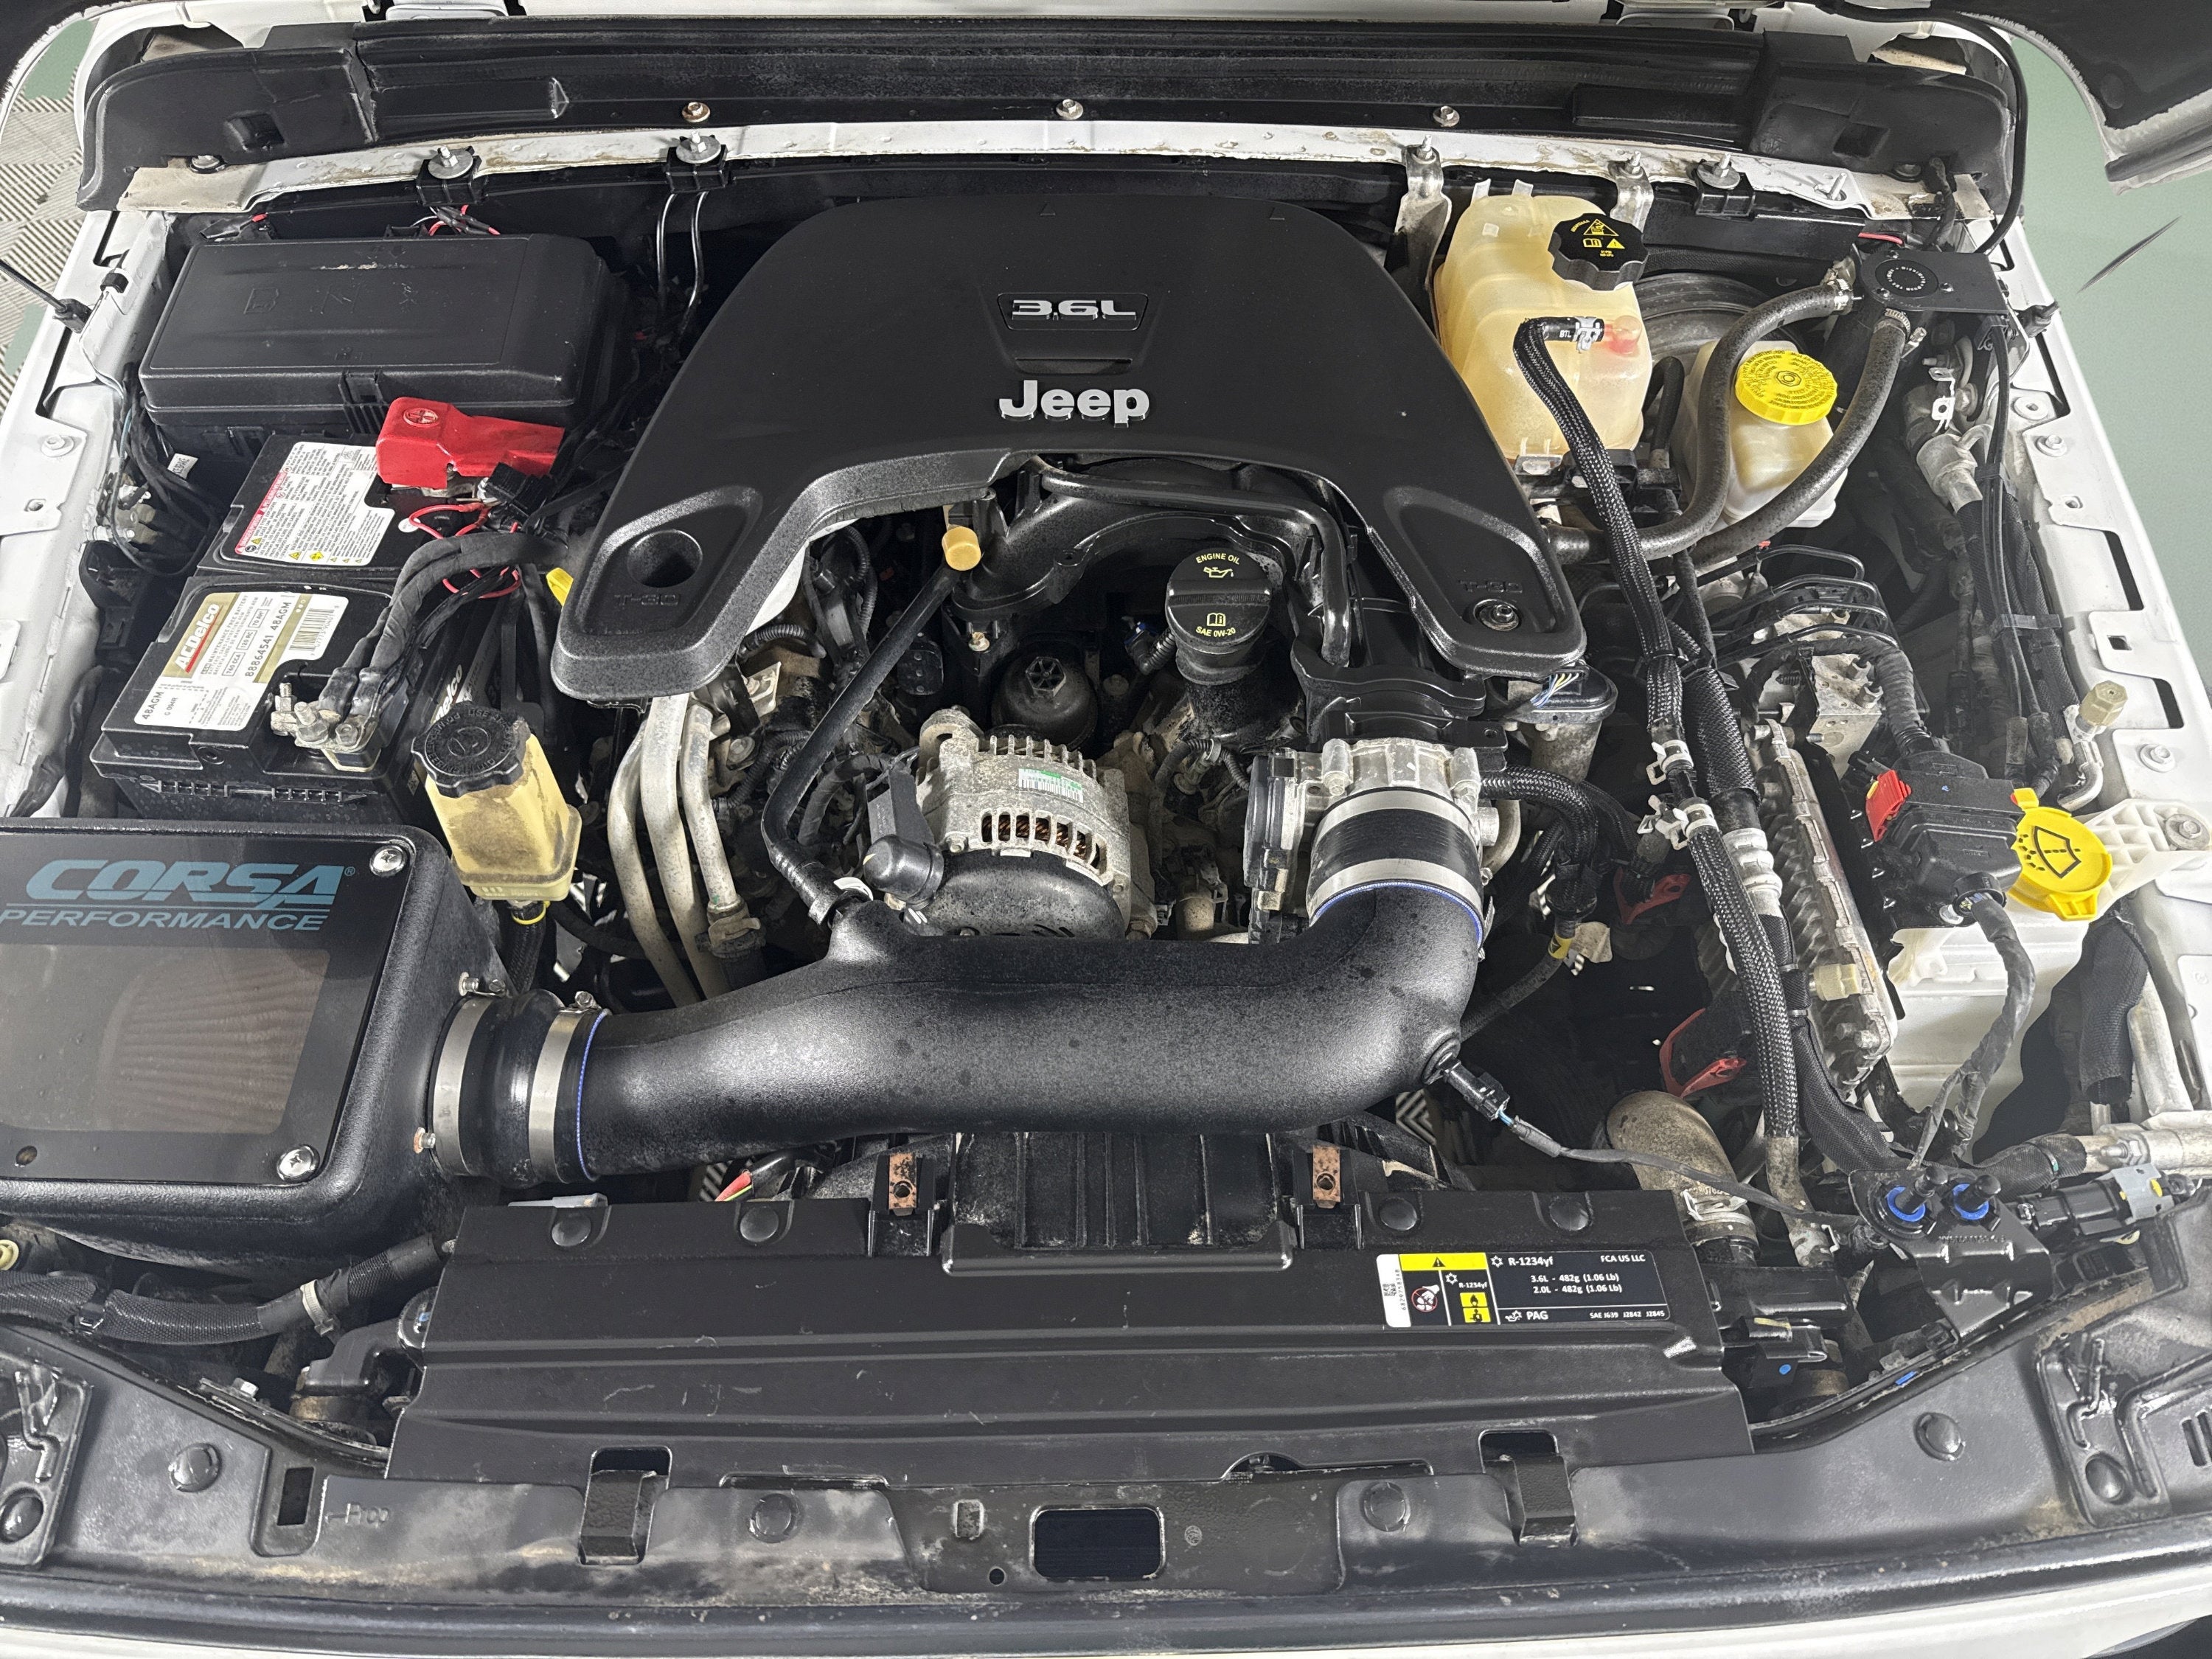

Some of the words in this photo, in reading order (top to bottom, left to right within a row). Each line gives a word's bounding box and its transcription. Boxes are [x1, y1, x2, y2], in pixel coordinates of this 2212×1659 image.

[1012, 299, 1136, 320] 3.6L
[998, 379, 1150, 426] Jeep
[1195, 553, 1226, 564] ENGINE
[1228, 554, 1240, 565] OIL
[175, 603, 220, 670] ACDelco
[245, 635, 274, 677] 88864541
[270, 602, 291, 631] 48AGM
[246, 630, 254, 639] RC
[1195, 626, 1211, 636] SAE
[1213, 627, 1236, 637] 0W-20
[226, 663, 236, 675] 760
[232, 653, 242, 663] CCA
[141, 691, 164, 720] 48AGM
[26, 859, 345, 909] CORSA
[0, 909, 329, 931] PERFORMANCE
[1508, 1256, 1554, 1267] R-1234yf
[1458, 1281, 1488, 1290] R-1234yf
[1530, 1274, 1549, 1283] 3.6L
[1559, 1274, 1579, 1284] 482g
[1582, 1273, 1603, 1284] (1.06
[1604, 1273, 1620, 1283] Lb)
[1532, 1285, 1551, 1294] 2.0L
[1562, 1284, 1582, 1295] 482g
[1585, 1284, 1606, 1294] (1.06
[1607, 1284, 1623, 1293] Lb)
[1526, 1311, 1548, 1321] PAG
